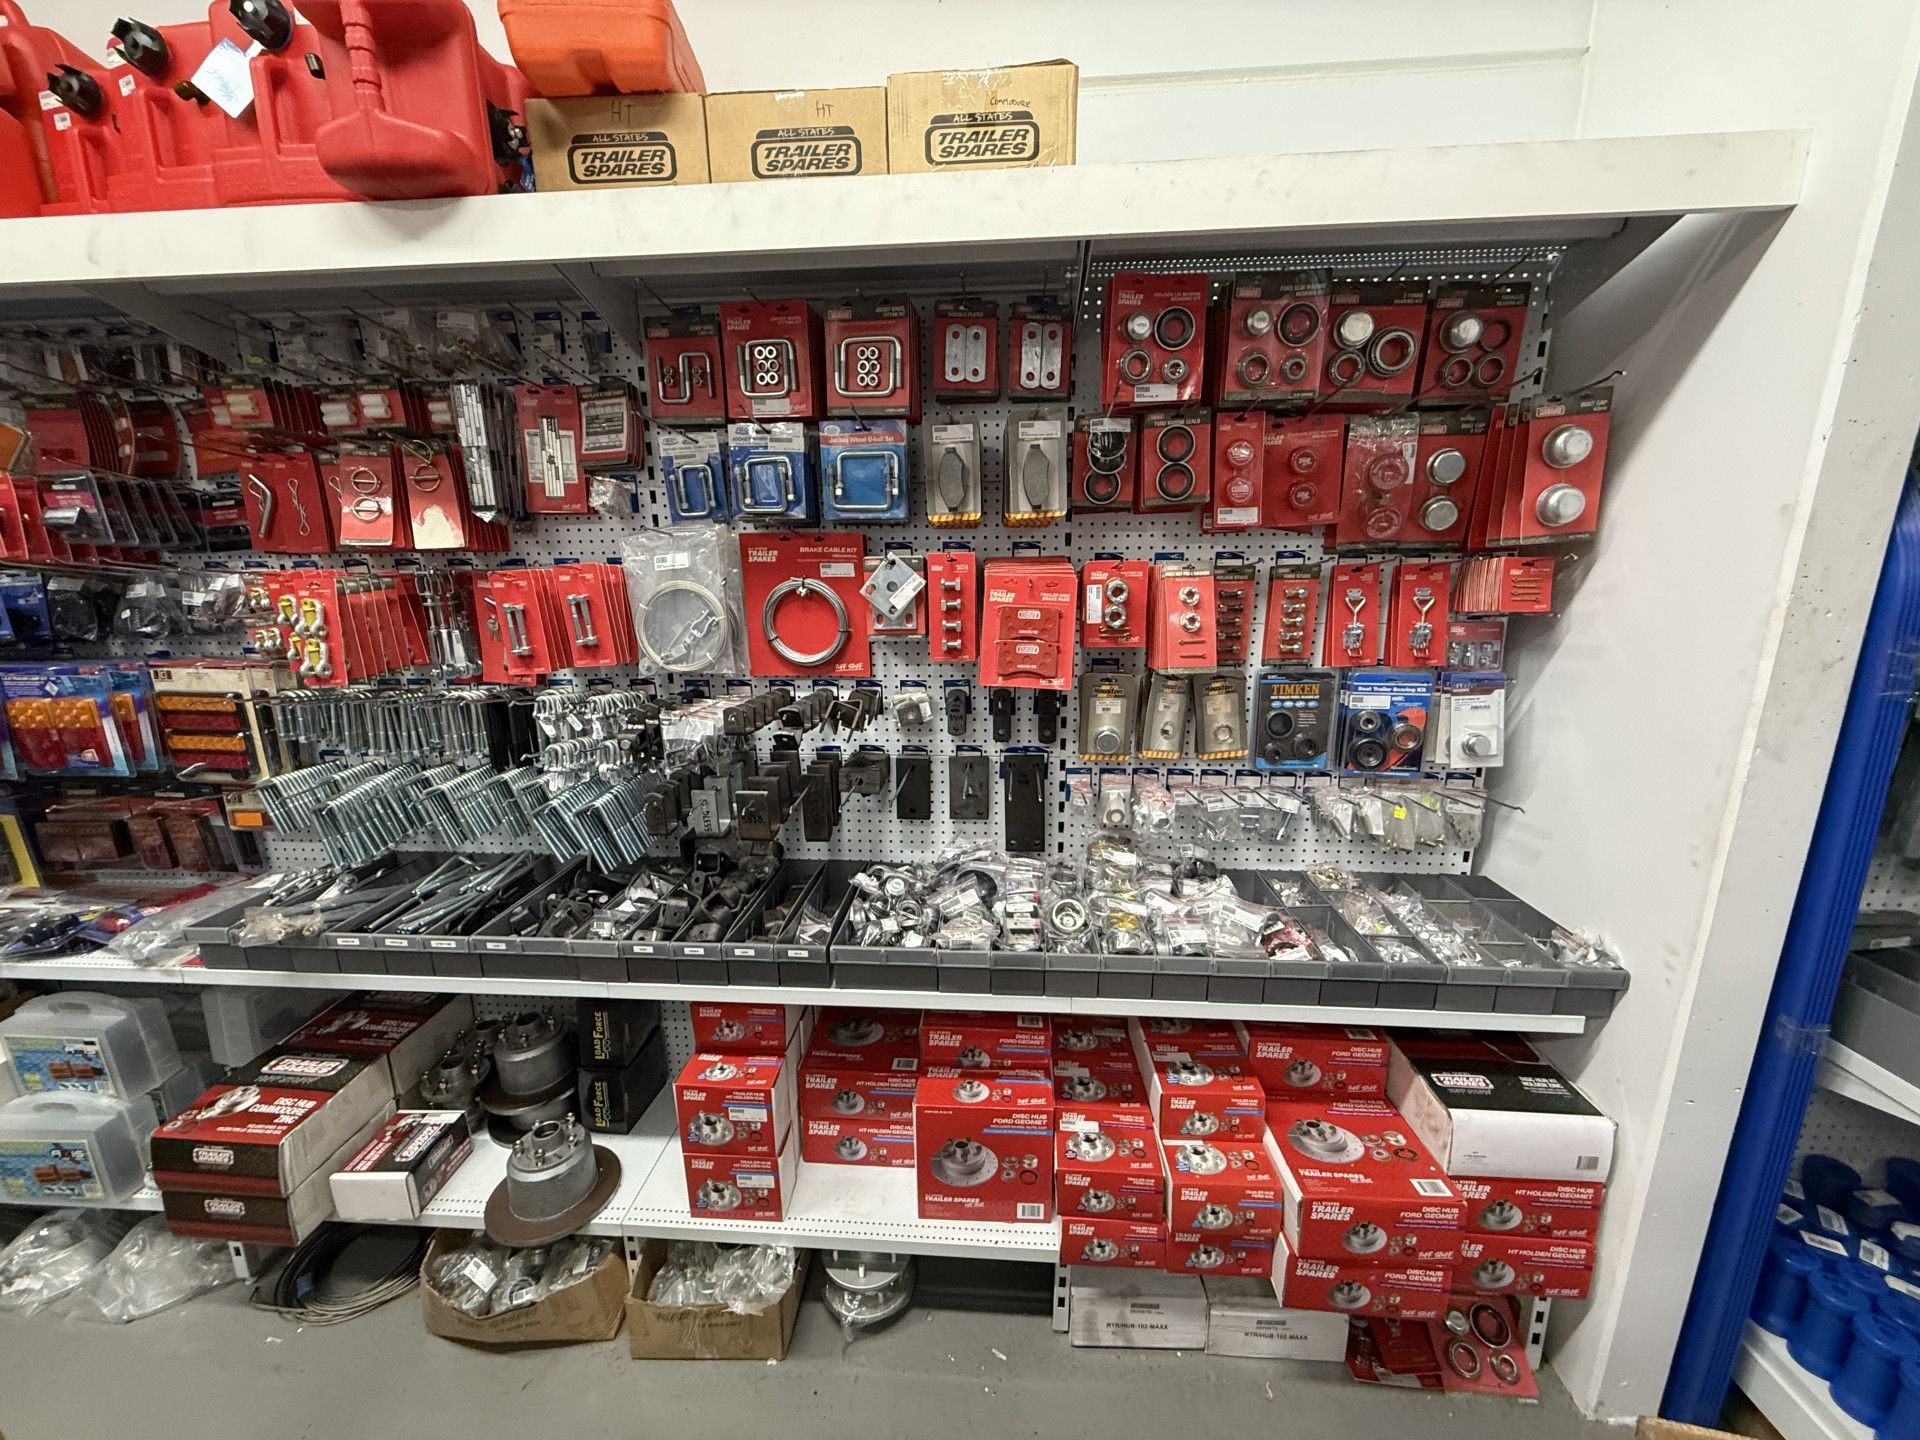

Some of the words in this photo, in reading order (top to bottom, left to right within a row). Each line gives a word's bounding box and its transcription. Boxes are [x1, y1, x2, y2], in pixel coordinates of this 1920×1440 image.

[611, 100, 632, 124] HT
[816, 100, 833, 118] HT
[953, 113, 968, 123] ALL
[975, 112, 1013, 122] STATES
[778, 128, 795, 137] ALL
[798, 127, 835, 136] STATES
[939, 128, 1030, 145] TRAILER
[592, 134, 610, 142] ALL
[614, 133, 649, 142] STATES
[764, 143, 852, 159] TRAILER
[939, 142, 1027, 158] SPARES
[581, 149, 666, 164] TRAILER
[765, 156, 851, 172] SPARES
[583, 162, 665, 177] SPARES
[1272, 684, 1320, 695] TIMKEN
[1257, 1046, 1293, 1054] TRAILER
[273, 1097, 299, 1106] DISC
[295, 1099, 317, 1108] HUB
[248, 1104, 309, 1116] COMMODORE
[273, 1115, 300, 1124] ZINC
[1300, 1170, 1333, 1178] TRAILER
[1527, 1190, 1559, 1198] HOLDEN
[1311, 1205, 1354, 1215] TRAILER
[1310, 1213, 1351, 1221] SPARES
[1552, 1251, 1587, 1259] GEOMET
[1296, 1263, 1339, 1273] TRAILER
[1295, 1270, 1336, 1279] SPARES
[1409, 1274, 1444, 1282] GEOMET
